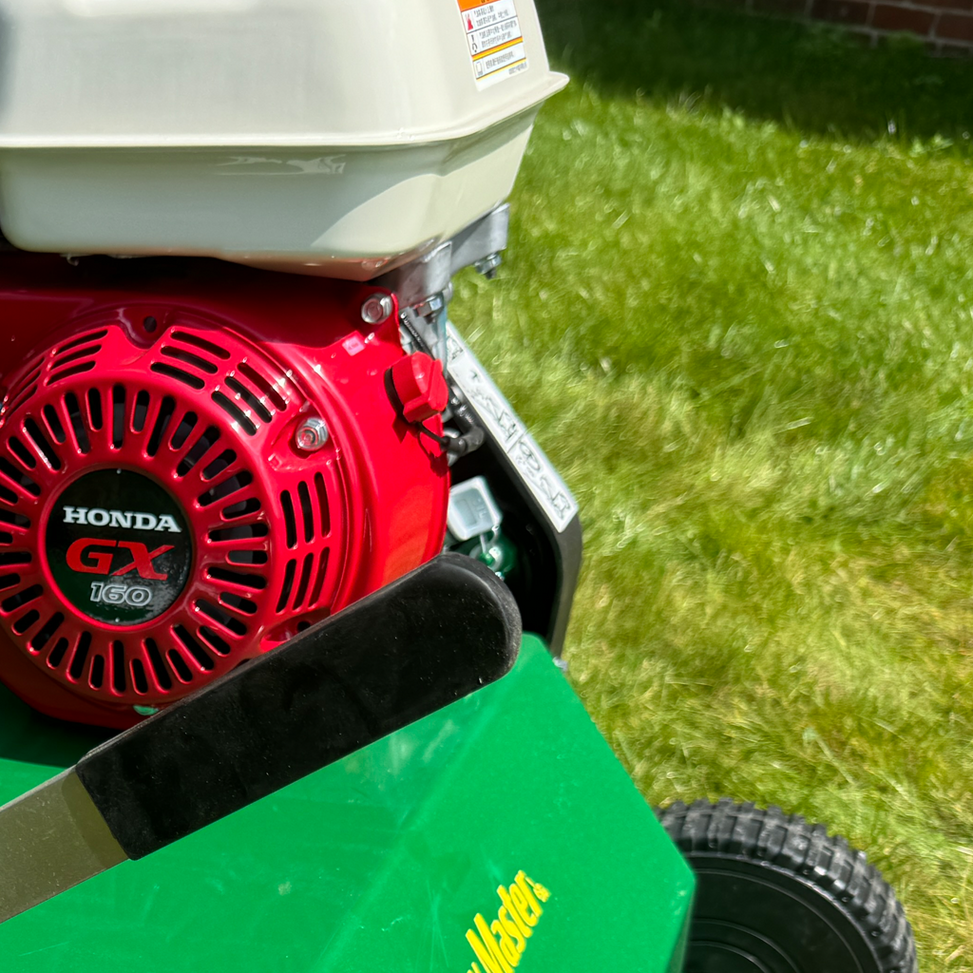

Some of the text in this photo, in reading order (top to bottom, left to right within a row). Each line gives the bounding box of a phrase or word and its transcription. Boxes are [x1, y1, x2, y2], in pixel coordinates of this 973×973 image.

[63, 505, 182, 533] HONDA
[66, 537, 175, 581] GX
[90, 581, 153, 607] 160
